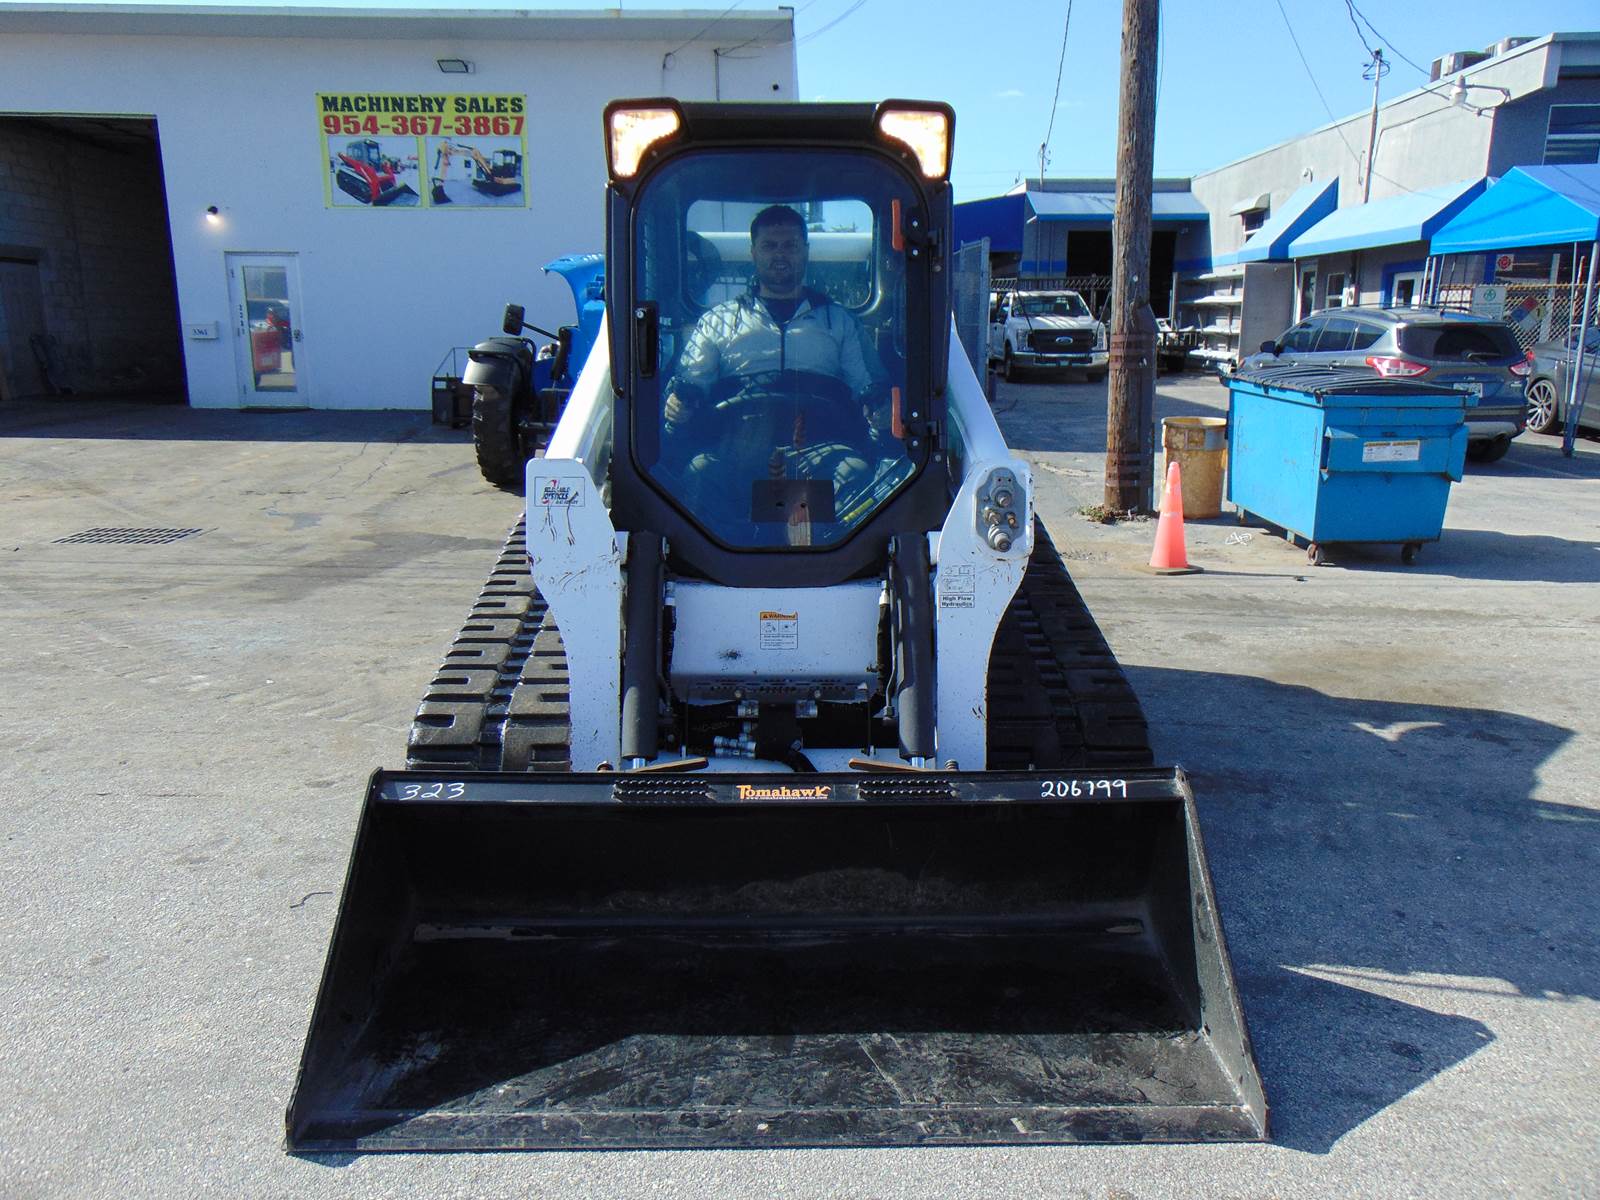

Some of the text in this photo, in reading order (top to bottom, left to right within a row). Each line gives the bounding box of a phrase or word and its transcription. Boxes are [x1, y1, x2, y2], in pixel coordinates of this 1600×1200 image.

[321, 96, 523, 113] MACHINERY SALES
[323, 115, 525, 136] 954-367-3867
[400, 782, 465, 801] 323
